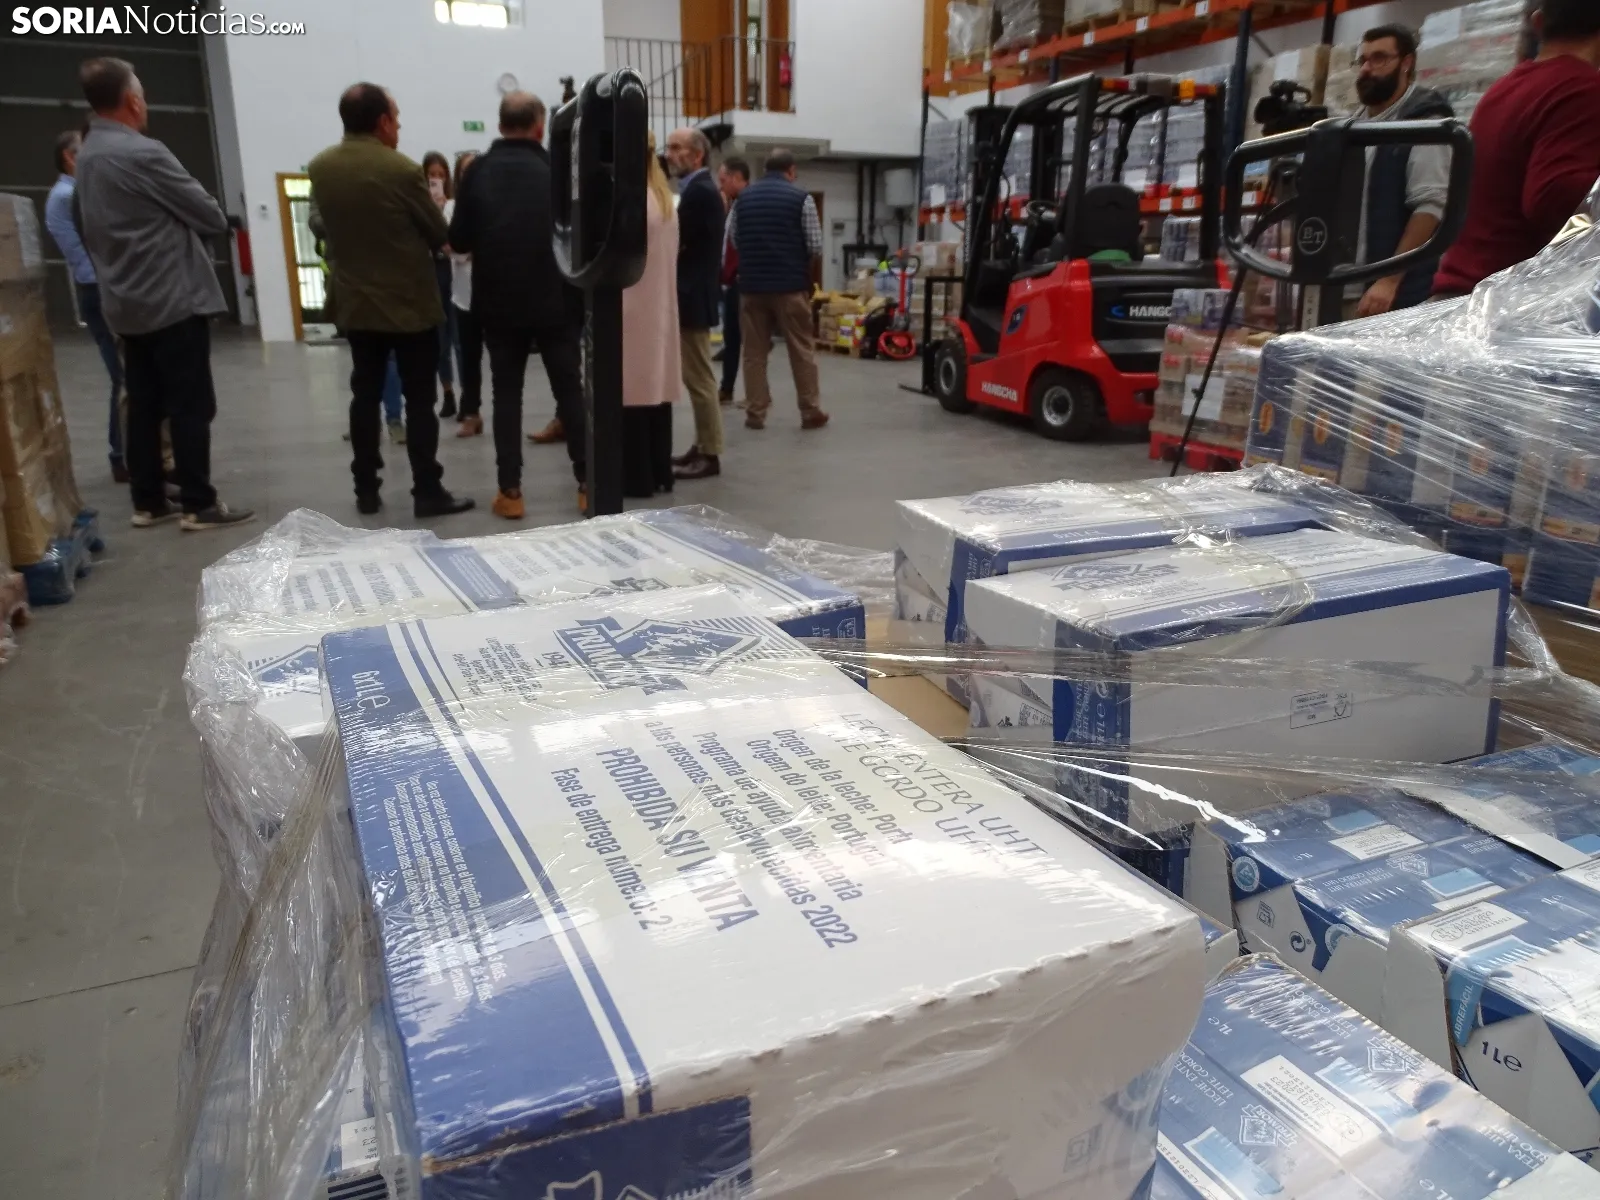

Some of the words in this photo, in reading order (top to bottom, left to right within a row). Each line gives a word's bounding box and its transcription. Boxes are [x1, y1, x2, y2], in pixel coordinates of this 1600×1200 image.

[981, 381, 1018, 402] HANGCHA
[650, 726, 675, 742] las
[551, 767, 582, 793] Fase
[658, 741, 713, 785] personas
[746, 739, 792, 774] Origem
[780, 772, 806, 786] do
[772, 729, 814, 758] Origen
[803, 757, 830, 771] de
[817, 769, 842, 782] la
[830, 781, 877, 814] leche:
[858, 755, 943, 814] GORDO
[566, 792, 589, 808] de
[596, 747, 686, 831] PROHIBIDA
[656, 829, 710, 858] SU
[692, 732, 746, 776] Programa
[734, 776, 758, 791] de
[747, 789, 794, 826] ayuda
[779, 825, 863, 901] alimentaria
[699, 783, 735, 808] más
[895, 753, 984, 814] ENTERA
[979, 817, 1048, 856] UHT
[574, 808, 622, 856] entrega
[800, 904, 858, 948] 2022
[1194, 1079, 1226, 1107] LECHE
[1206, 1075, 1234, 1099] LEITE
[1253, 1106, 1292, 1139] PRIMOR
